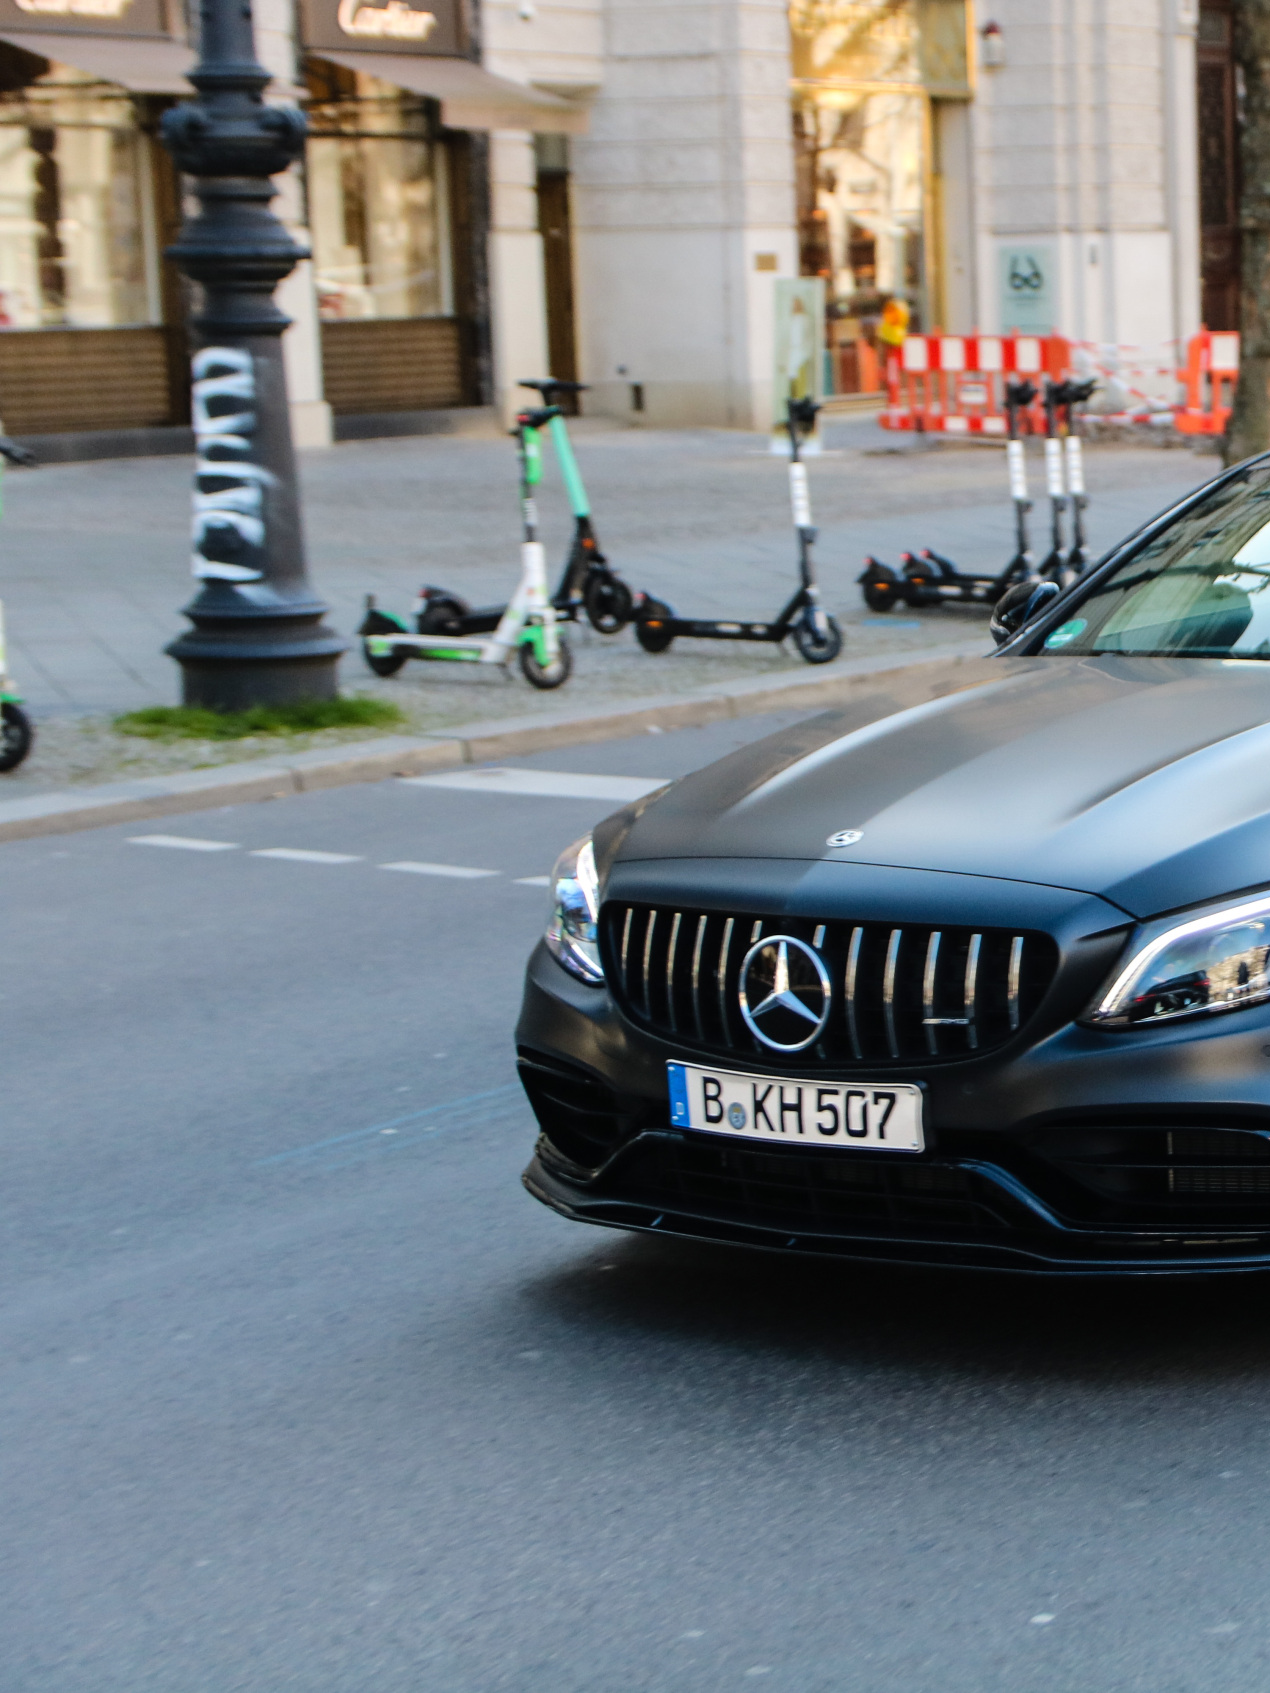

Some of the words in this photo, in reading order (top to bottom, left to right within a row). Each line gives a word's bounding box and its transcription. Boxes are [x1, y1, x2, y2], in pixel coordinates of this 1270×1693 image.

[702, 1076, 724, 1124] B
[752, 1082, 804, 1134] KH
[817, 1088, 897, 1139] 507
